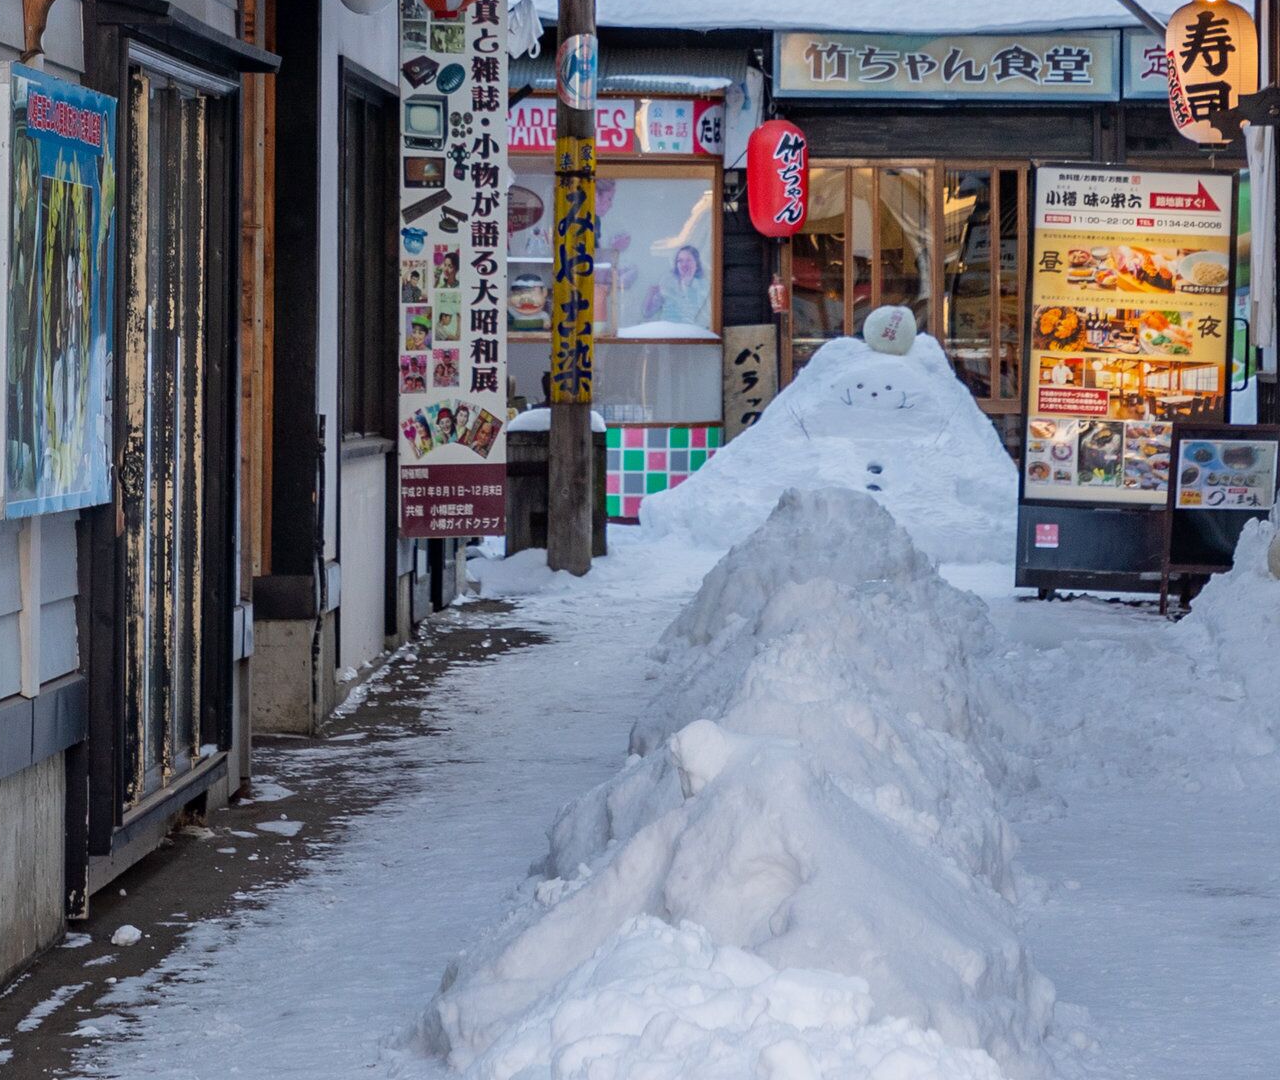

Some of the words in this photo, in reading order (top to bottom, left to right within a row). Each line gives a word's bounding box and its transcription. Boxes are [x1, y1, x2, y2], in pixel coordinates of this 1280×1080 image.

[804, 42, 1094, 85] 竹ちゃん食堂
[1141, 44, 1168, 78] 定
[1180, 11, 1235, 122] 寿司
[775, 132, 806, 225] 竹ちゃん
[1046, 190, 1077, 207] 小樽
[1084, 193, 1142, 209] 味の栄六
[1039, 251, 1063, 273] 昼
[1197, 316, 1222, 338] 夜
[430, 517, 500, 530] 小樽ガイドクラブ
